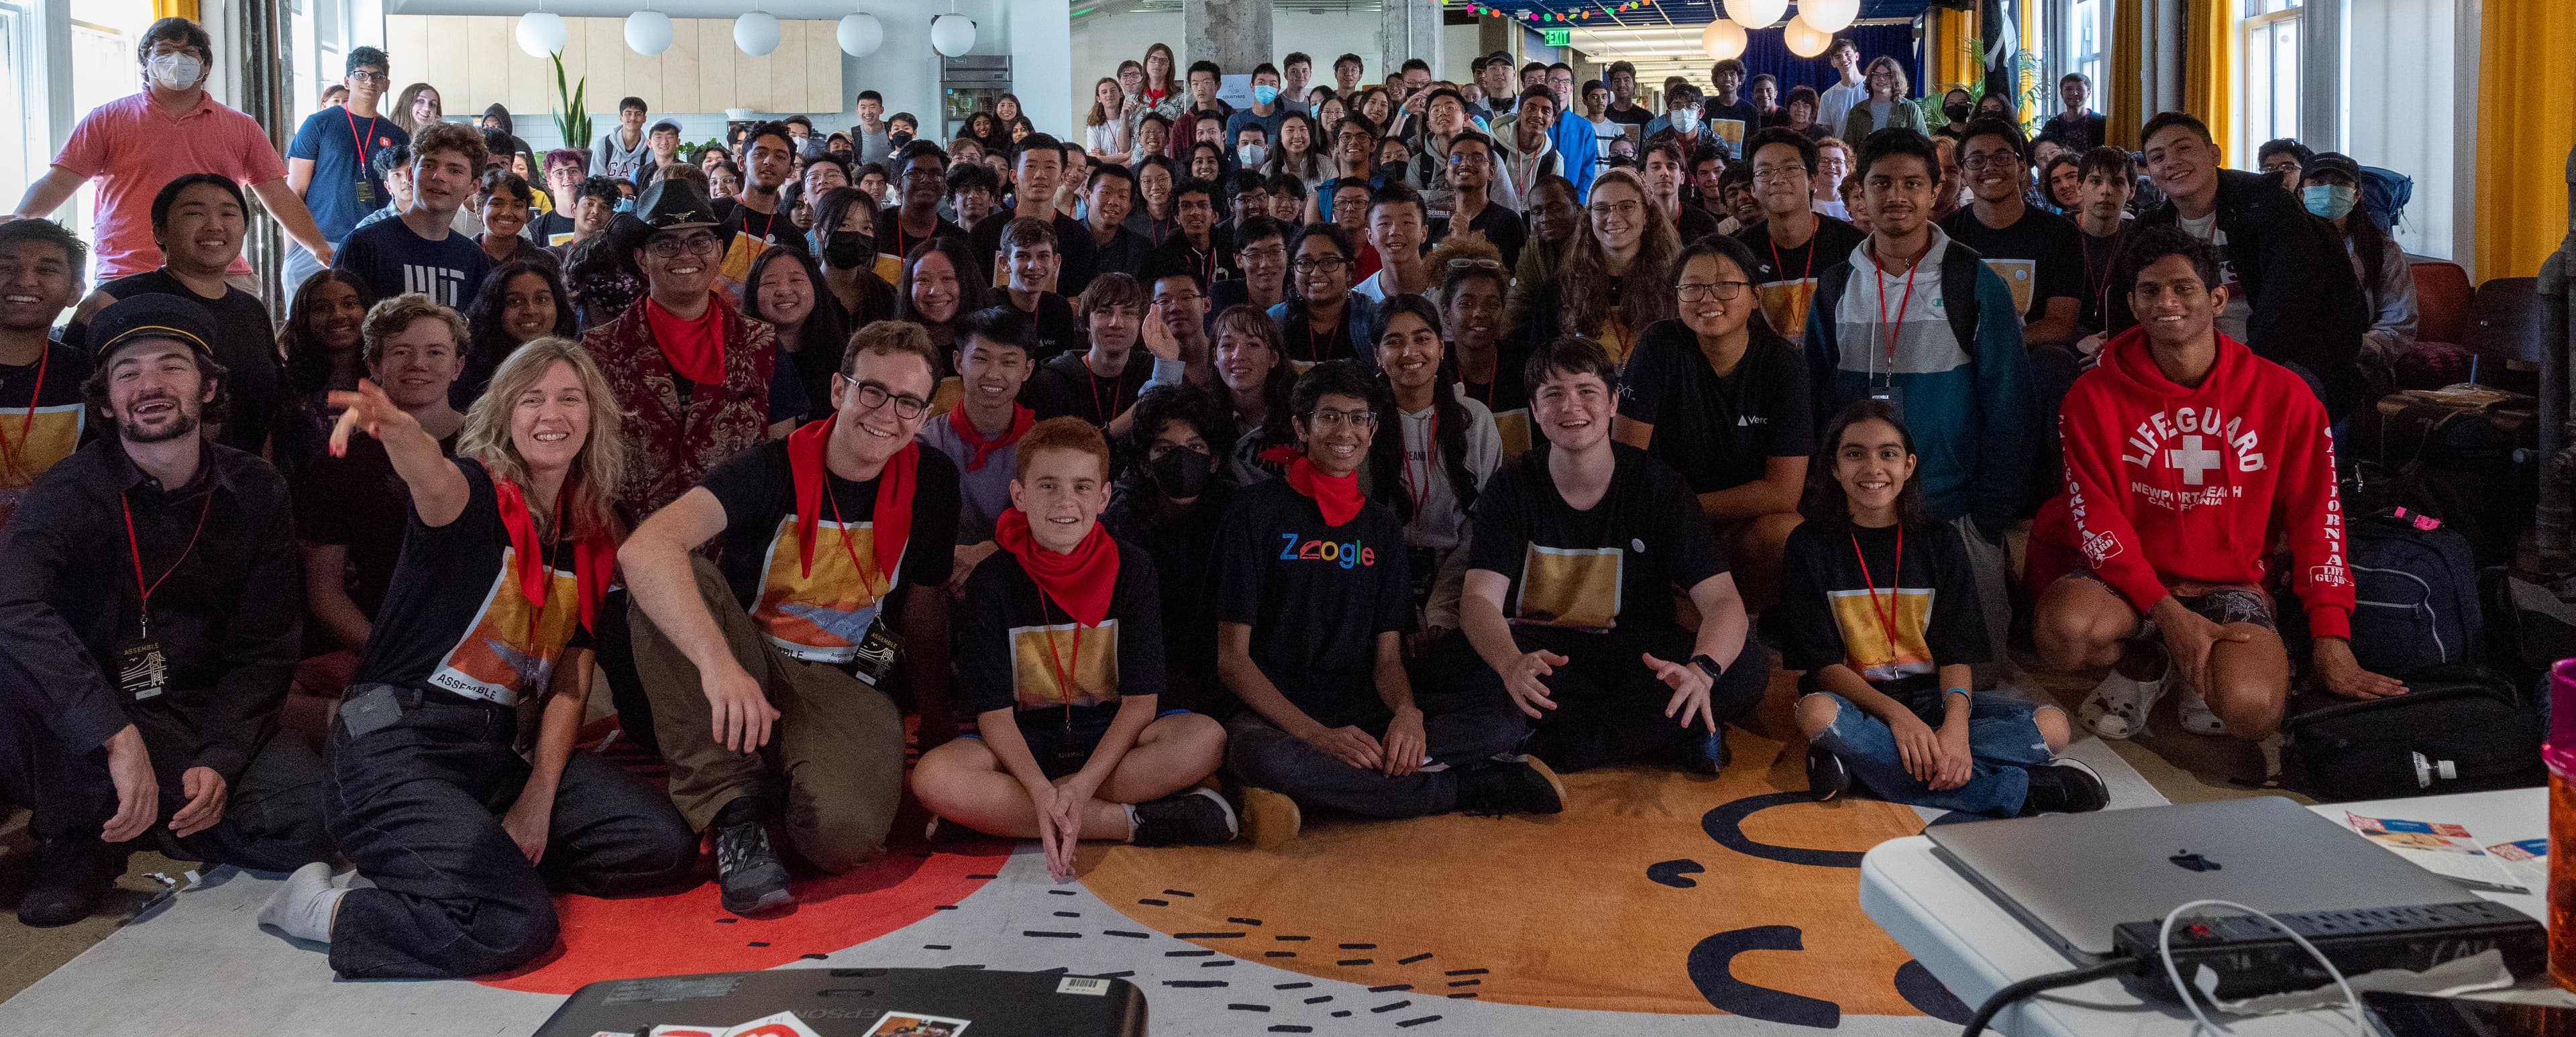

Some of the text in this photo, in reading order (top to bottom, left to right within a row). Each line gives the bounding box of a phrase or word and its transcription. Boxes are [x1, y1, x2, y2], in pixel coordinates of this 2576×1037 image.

[1549, 31, 1568, 44] EXIT
[2123, 406, 2265, 472] LIFEGUARD
[2088, 539, 2114, 559] UARD
[124, 643, 159, 655] ASSEMBLE
[872, 633, 898, 649] ASSEMBLE
